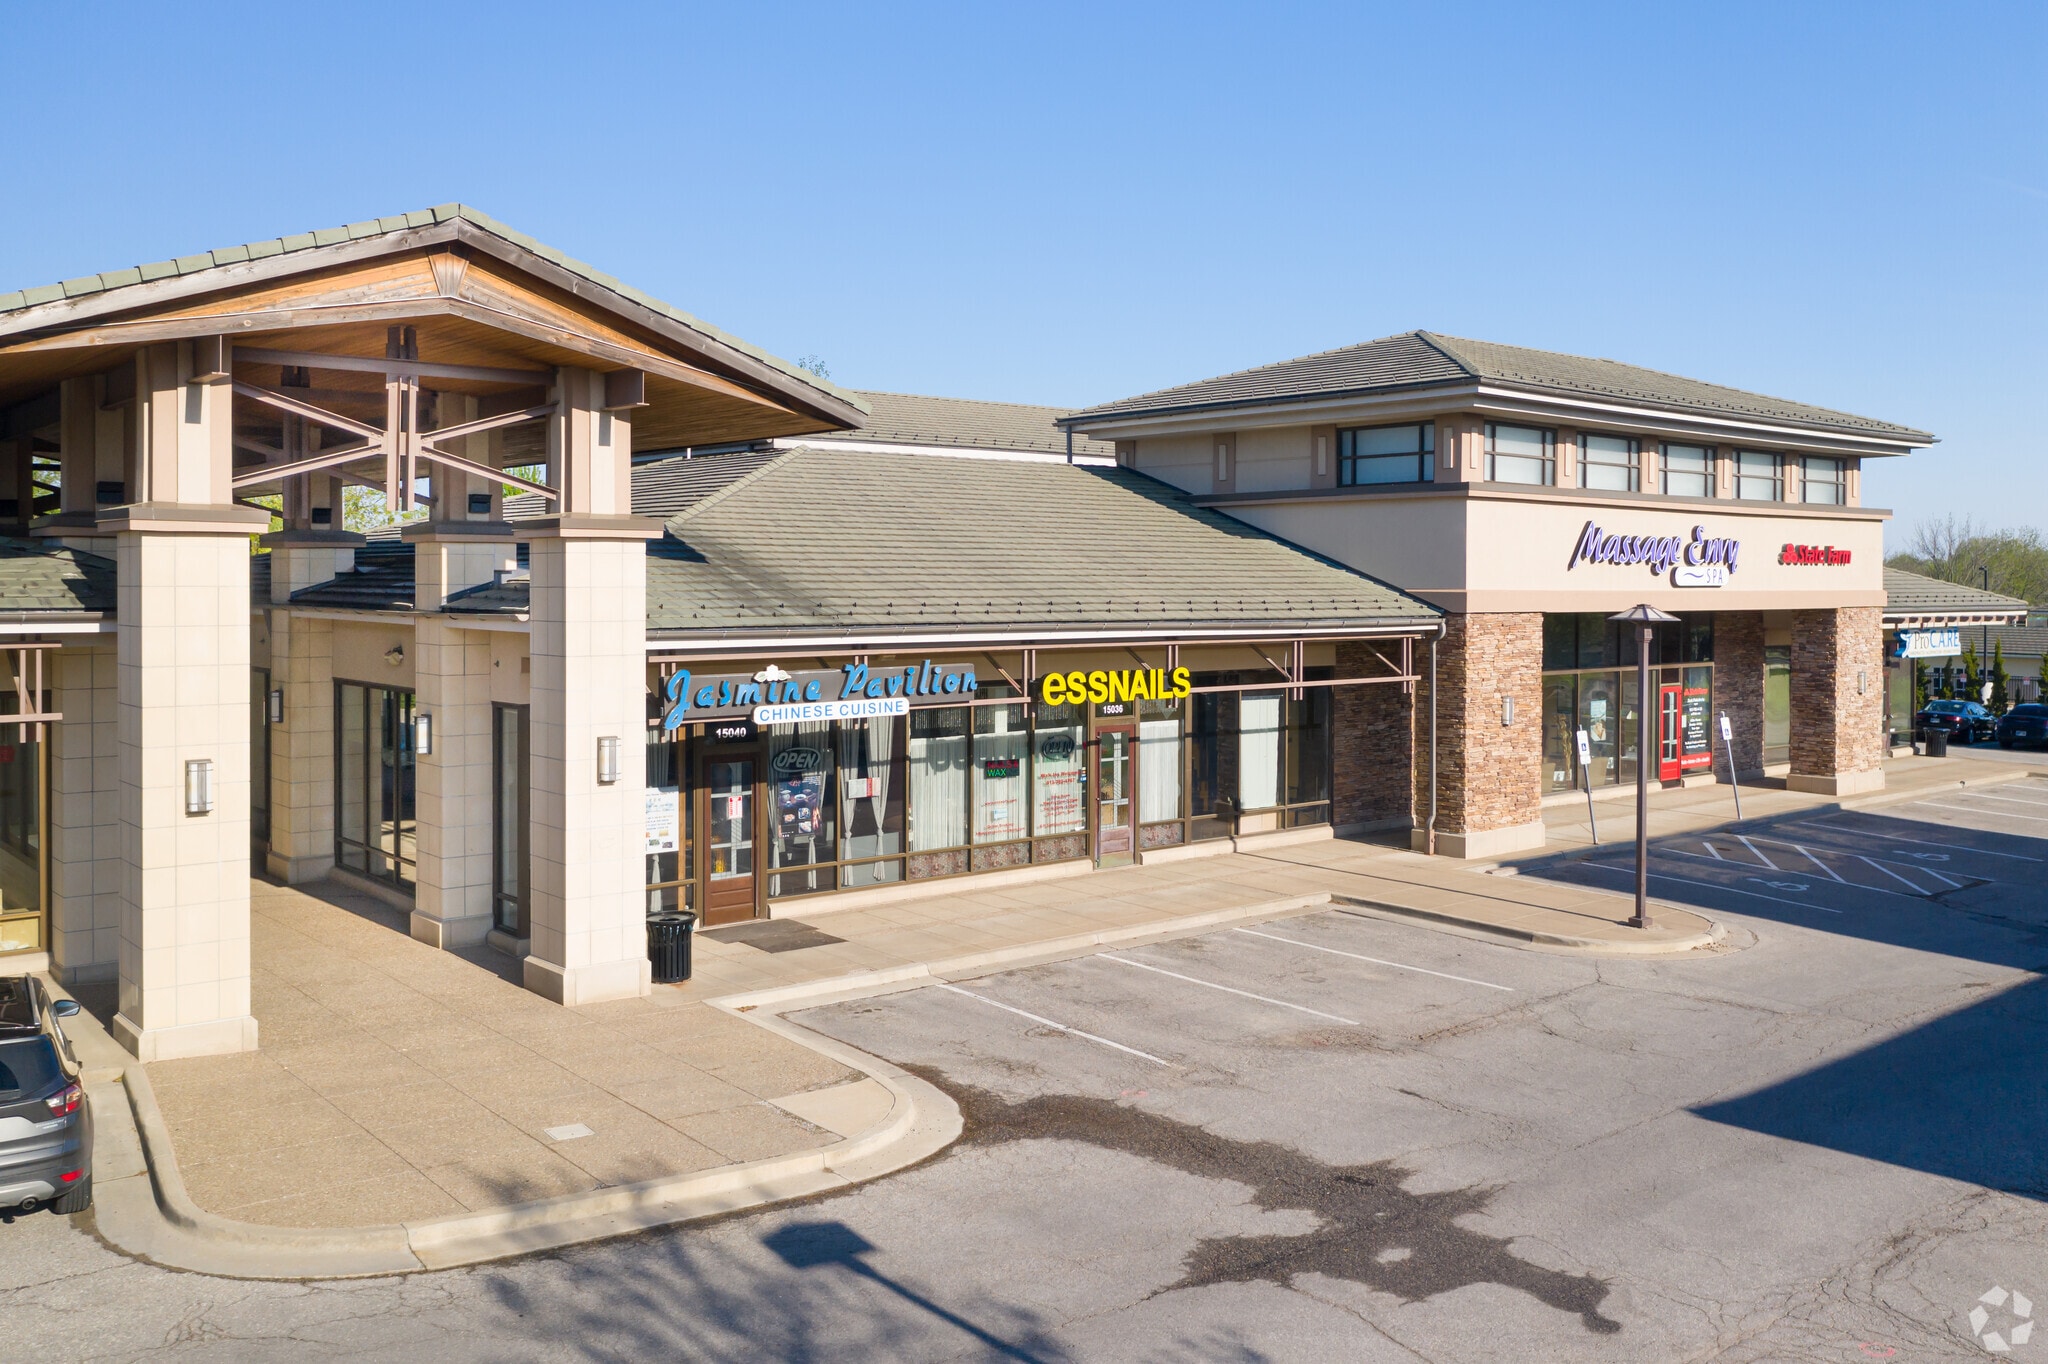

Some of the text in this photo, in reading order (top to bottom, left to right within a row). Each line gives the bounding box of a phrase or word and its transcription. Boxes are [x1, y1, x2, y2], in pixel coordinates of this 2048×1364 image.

[1571, 520, 1740, 574] Massage Envy
[1797, 544, 1851, 564] State Farm
[1706, 568, 1723, 584] SPA
[664, 659, 978, 731] Jasmine Pavilion
[759, 700, 904, 722] CHINESE CUISINE
[1102, 704, 1124, 714] 15036
[715, 727, 747, 739] 15040
[776, 752, 817, 769] OPEN
